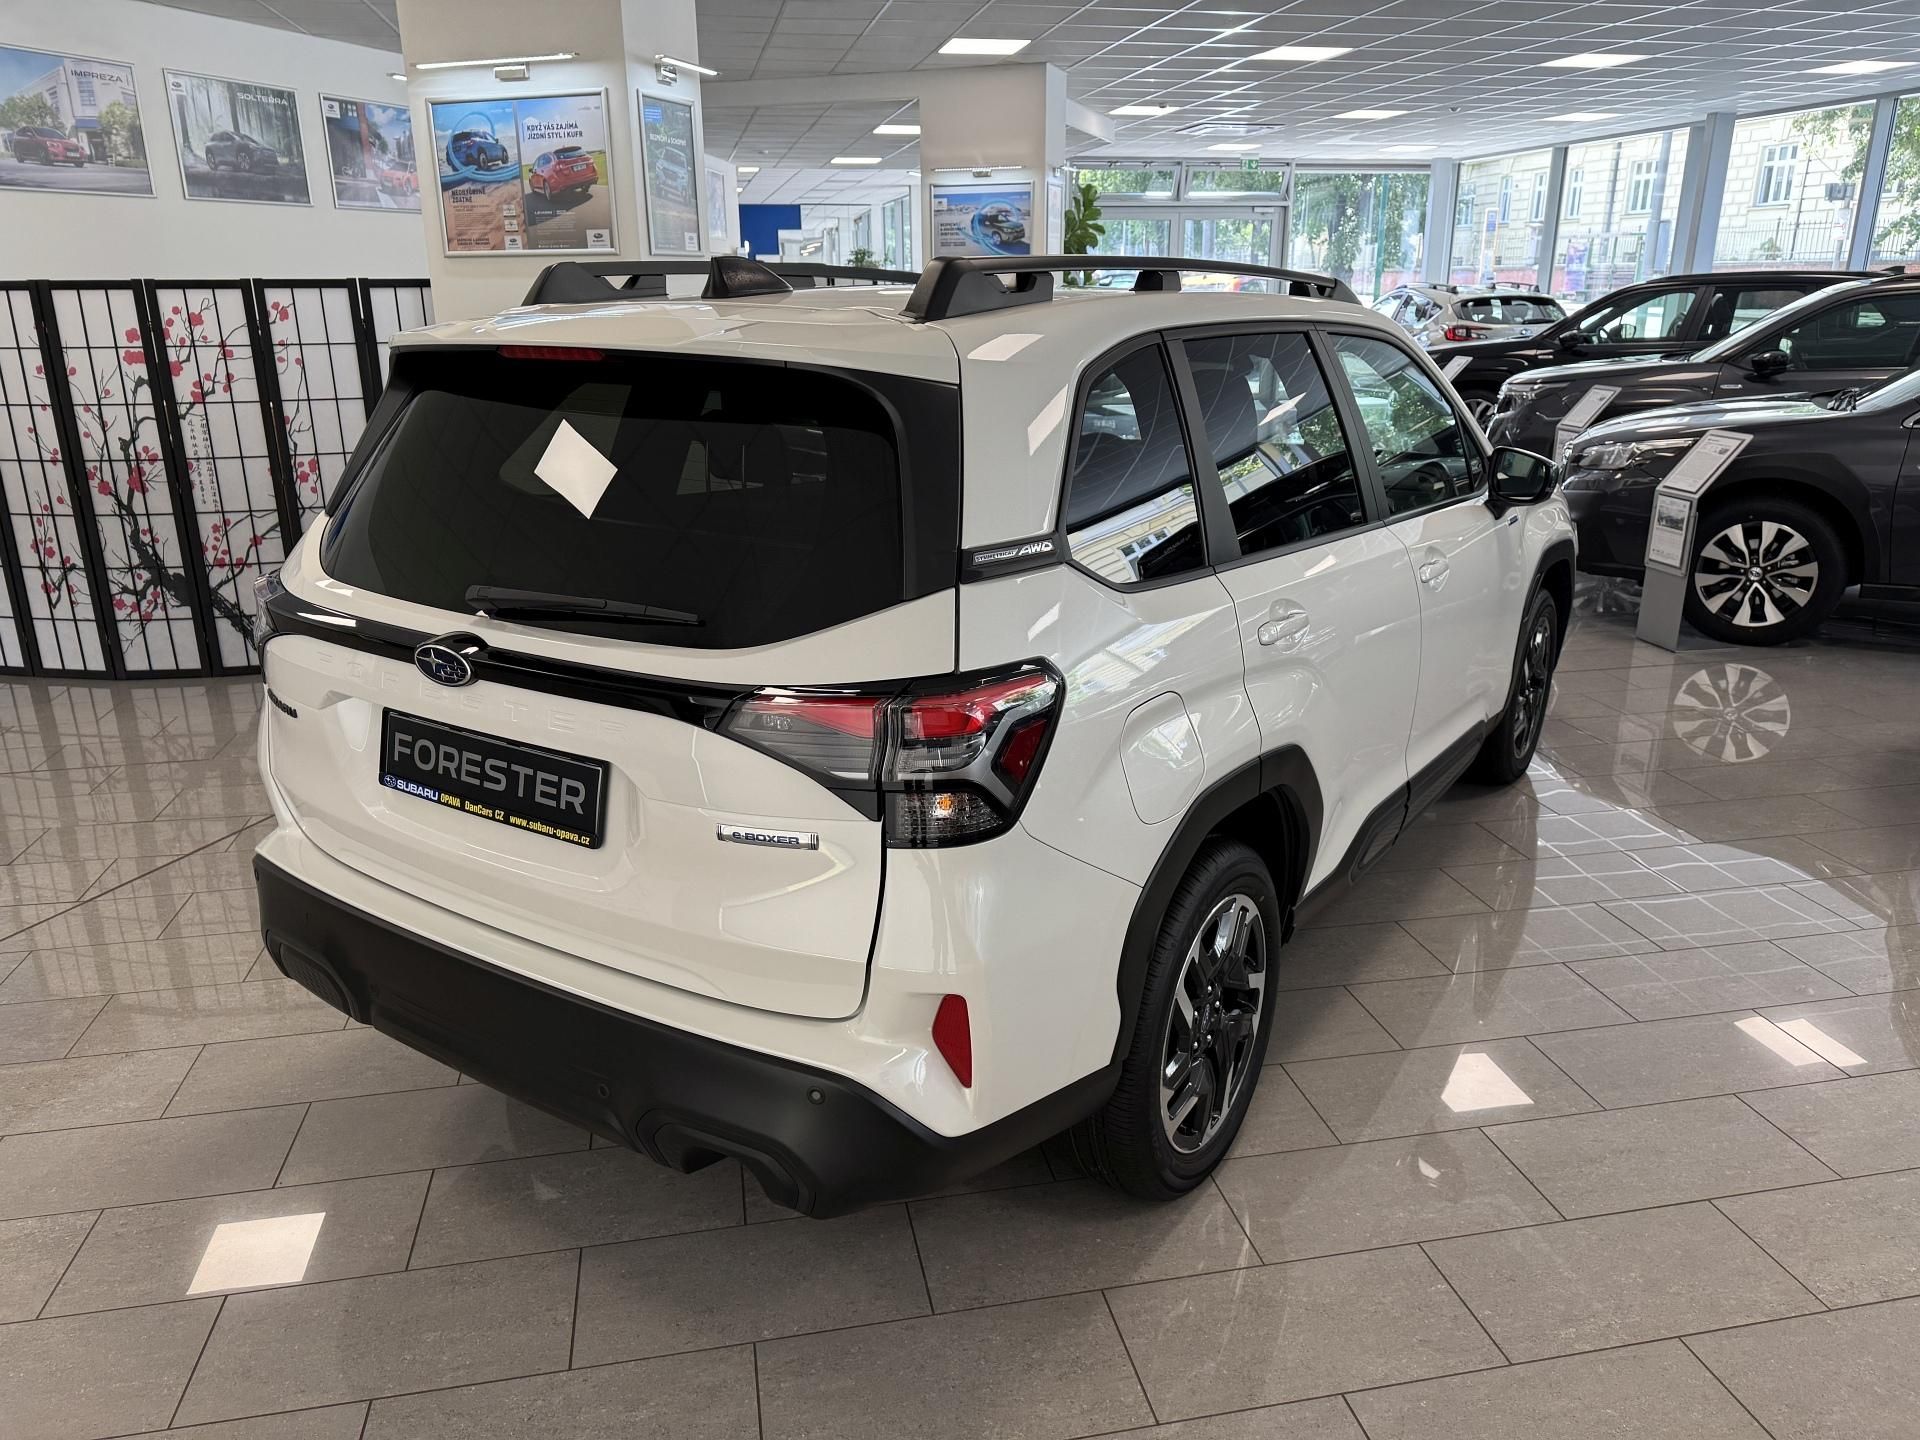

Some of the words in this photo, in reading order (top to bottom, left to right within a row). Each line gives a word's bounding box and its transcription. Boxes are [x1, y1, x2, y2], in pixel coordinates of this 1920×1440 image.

[71, 69, 123, 83] IMPREZA
[236, 92, 288, 106] SOLTERRA
[526, 123, 542, 132] KDYŽ
[543, 121, 555, 131] VÁS
[555, 120, 579, 130] ZAJÍMÁ
[1019, 541, 1053, 556] AWD
[393, 731, 586, 815] FORESTER
[396, 779, 439, 801] SUBARU
[440, 793, 461, 808] OPAVA
[465, 801, 493, 817] DanCars
[494, 809, 505, 821] CZ
[509, 815, 590, 845] www.subaru-opava.cz
[732, 831, 800, 845] e-BOXER
